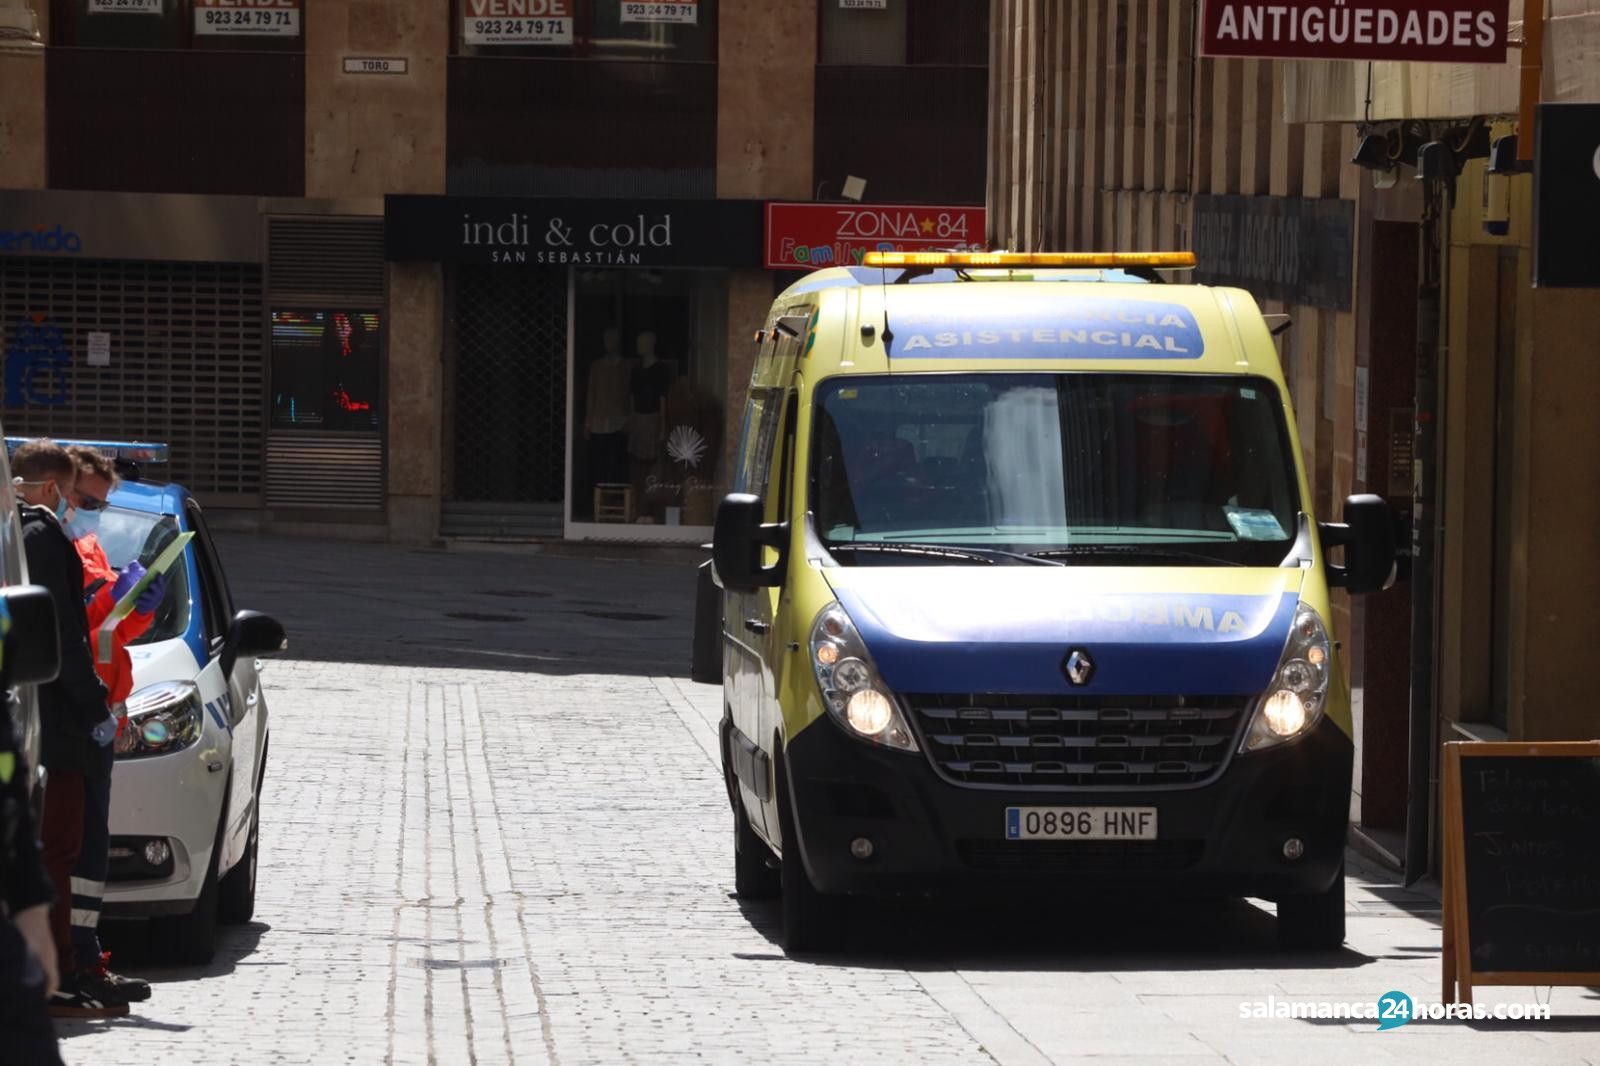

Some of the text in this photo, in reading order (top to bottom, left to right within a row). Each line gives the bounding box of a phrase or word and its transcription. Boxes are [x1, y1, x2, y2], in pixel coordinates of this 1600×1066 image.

[470, 0, 568, 15] VENDE
[626, 4, 645, 15] 923
[664, 6, 677, 15] 79
[680, 6, 692, 16] 71
[205, 11, 292, 25] 923 24 79 71
[1216, 0, 1496, 48] ANTIGÜEDADES
[475, 20, 565, 34] 923 24 79 71
[362, 61, 389, 71] TORO
[462, 213, 673, 247] indi & cold
[491, 250, 641, 265] SAN SEBASTIÁN
[779, 237, 866, 266] Family
[903, 328, 1189, 354] ASISTENCIAL
[1010, 811, 1153, 836] E 0896 HNF
